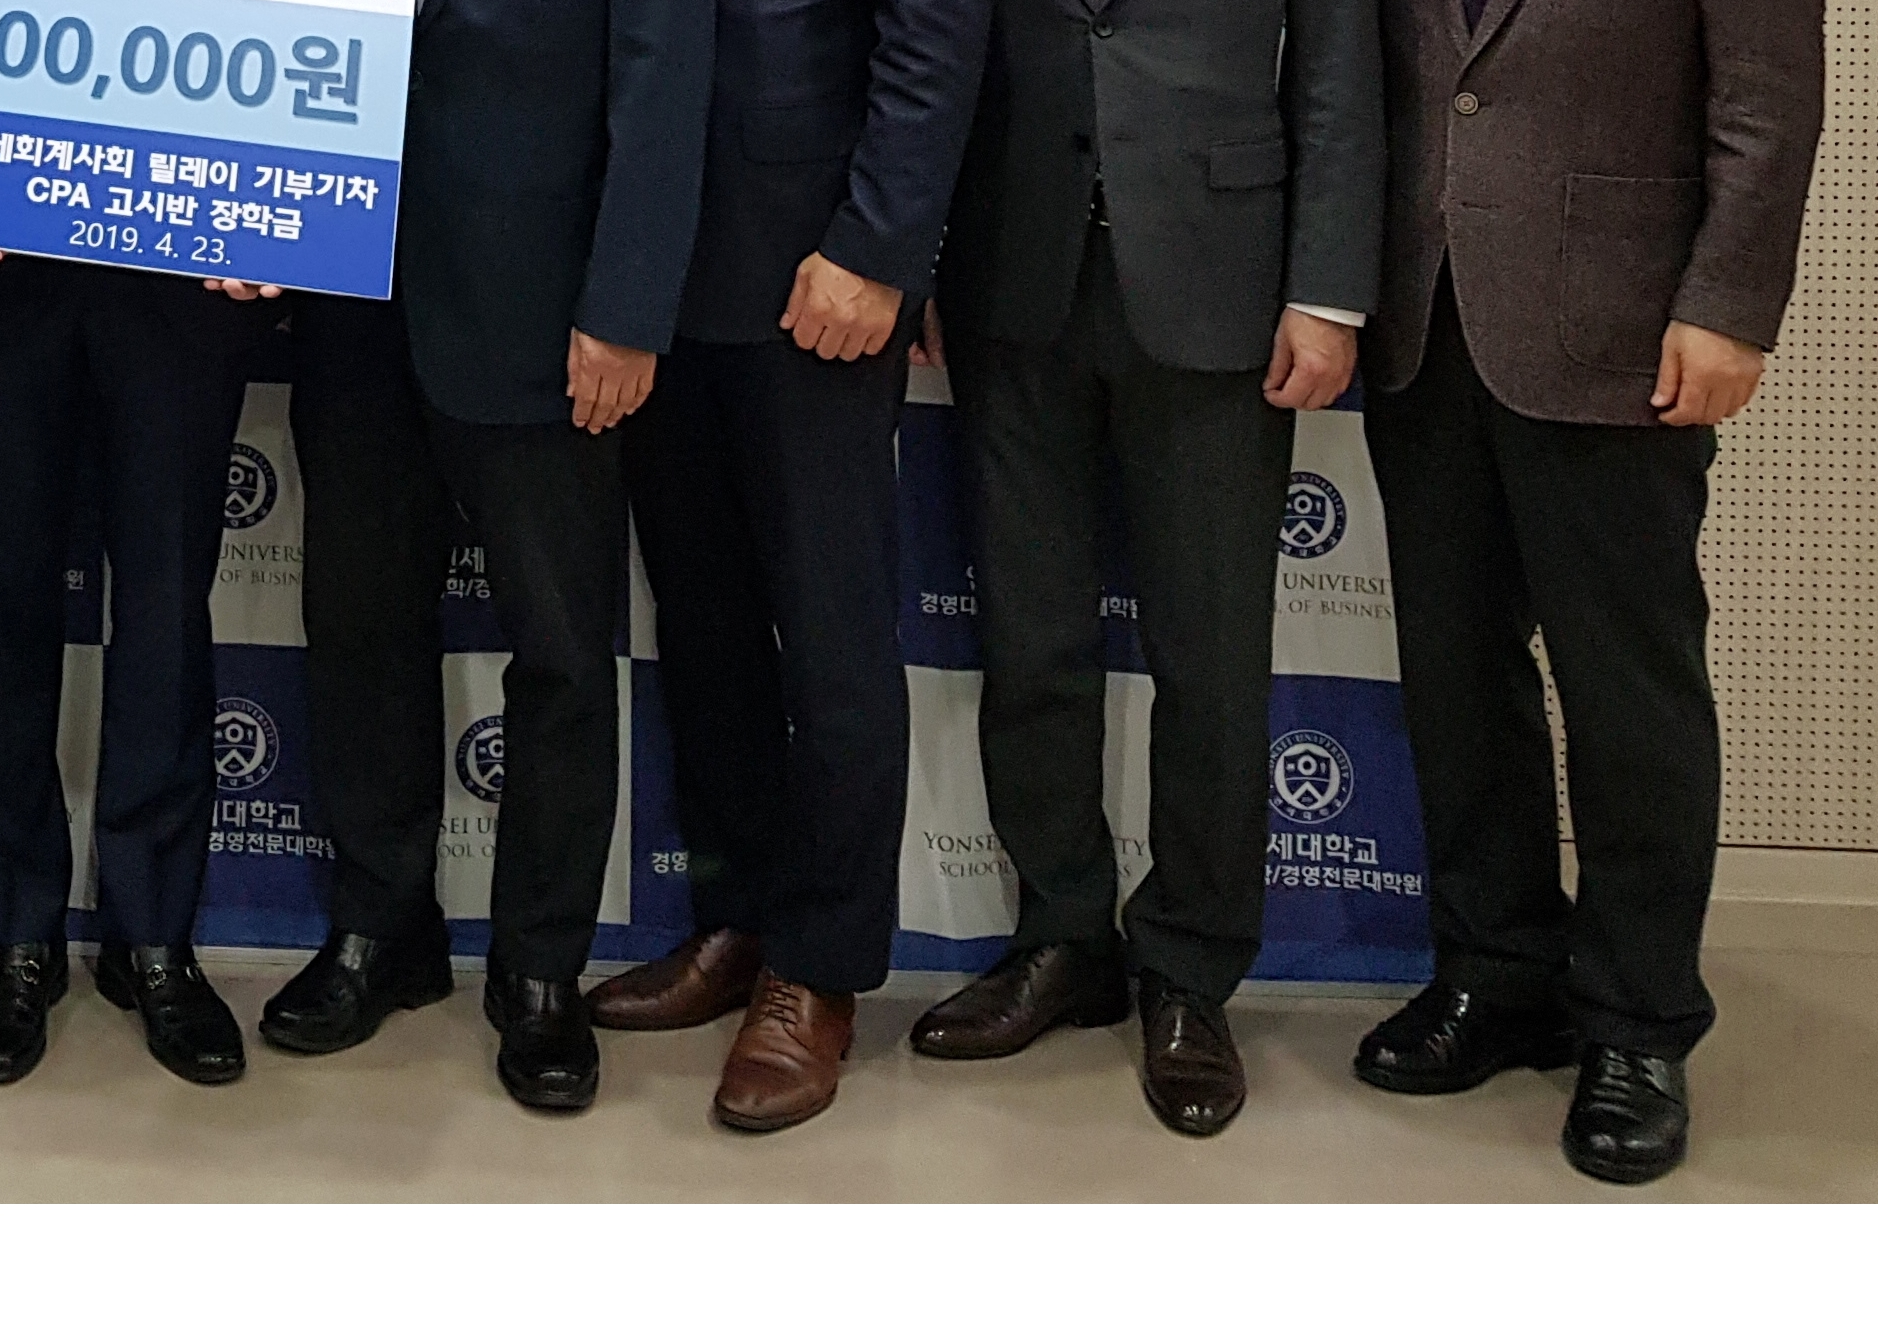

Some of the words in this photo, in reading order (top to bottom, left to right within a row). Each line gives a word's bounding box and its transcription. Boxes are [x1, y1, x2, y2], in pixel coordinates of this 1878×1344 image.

[149, 153, 239, 194] 릴레이
[254, 164, 379, 210] 기부기차
[26, 176, 91, 211] CPA
[104, 186, 199, 227] 고시반
[210, 199, 304, 241] 장학금
[68, 220, 144, 254] 2019.
[156, 234, 180, 259] 4.
[192, 236, 233, 266] 23.
[251, 570, 301, 586] BUSIN
[1283, 572, 1388, 596] UNIVERSI
[1322, 601, 1393, 620] BUSINES
[212, 799, 302, 830] 대학교
[1266, 832, 1380, 865] 세대학교
